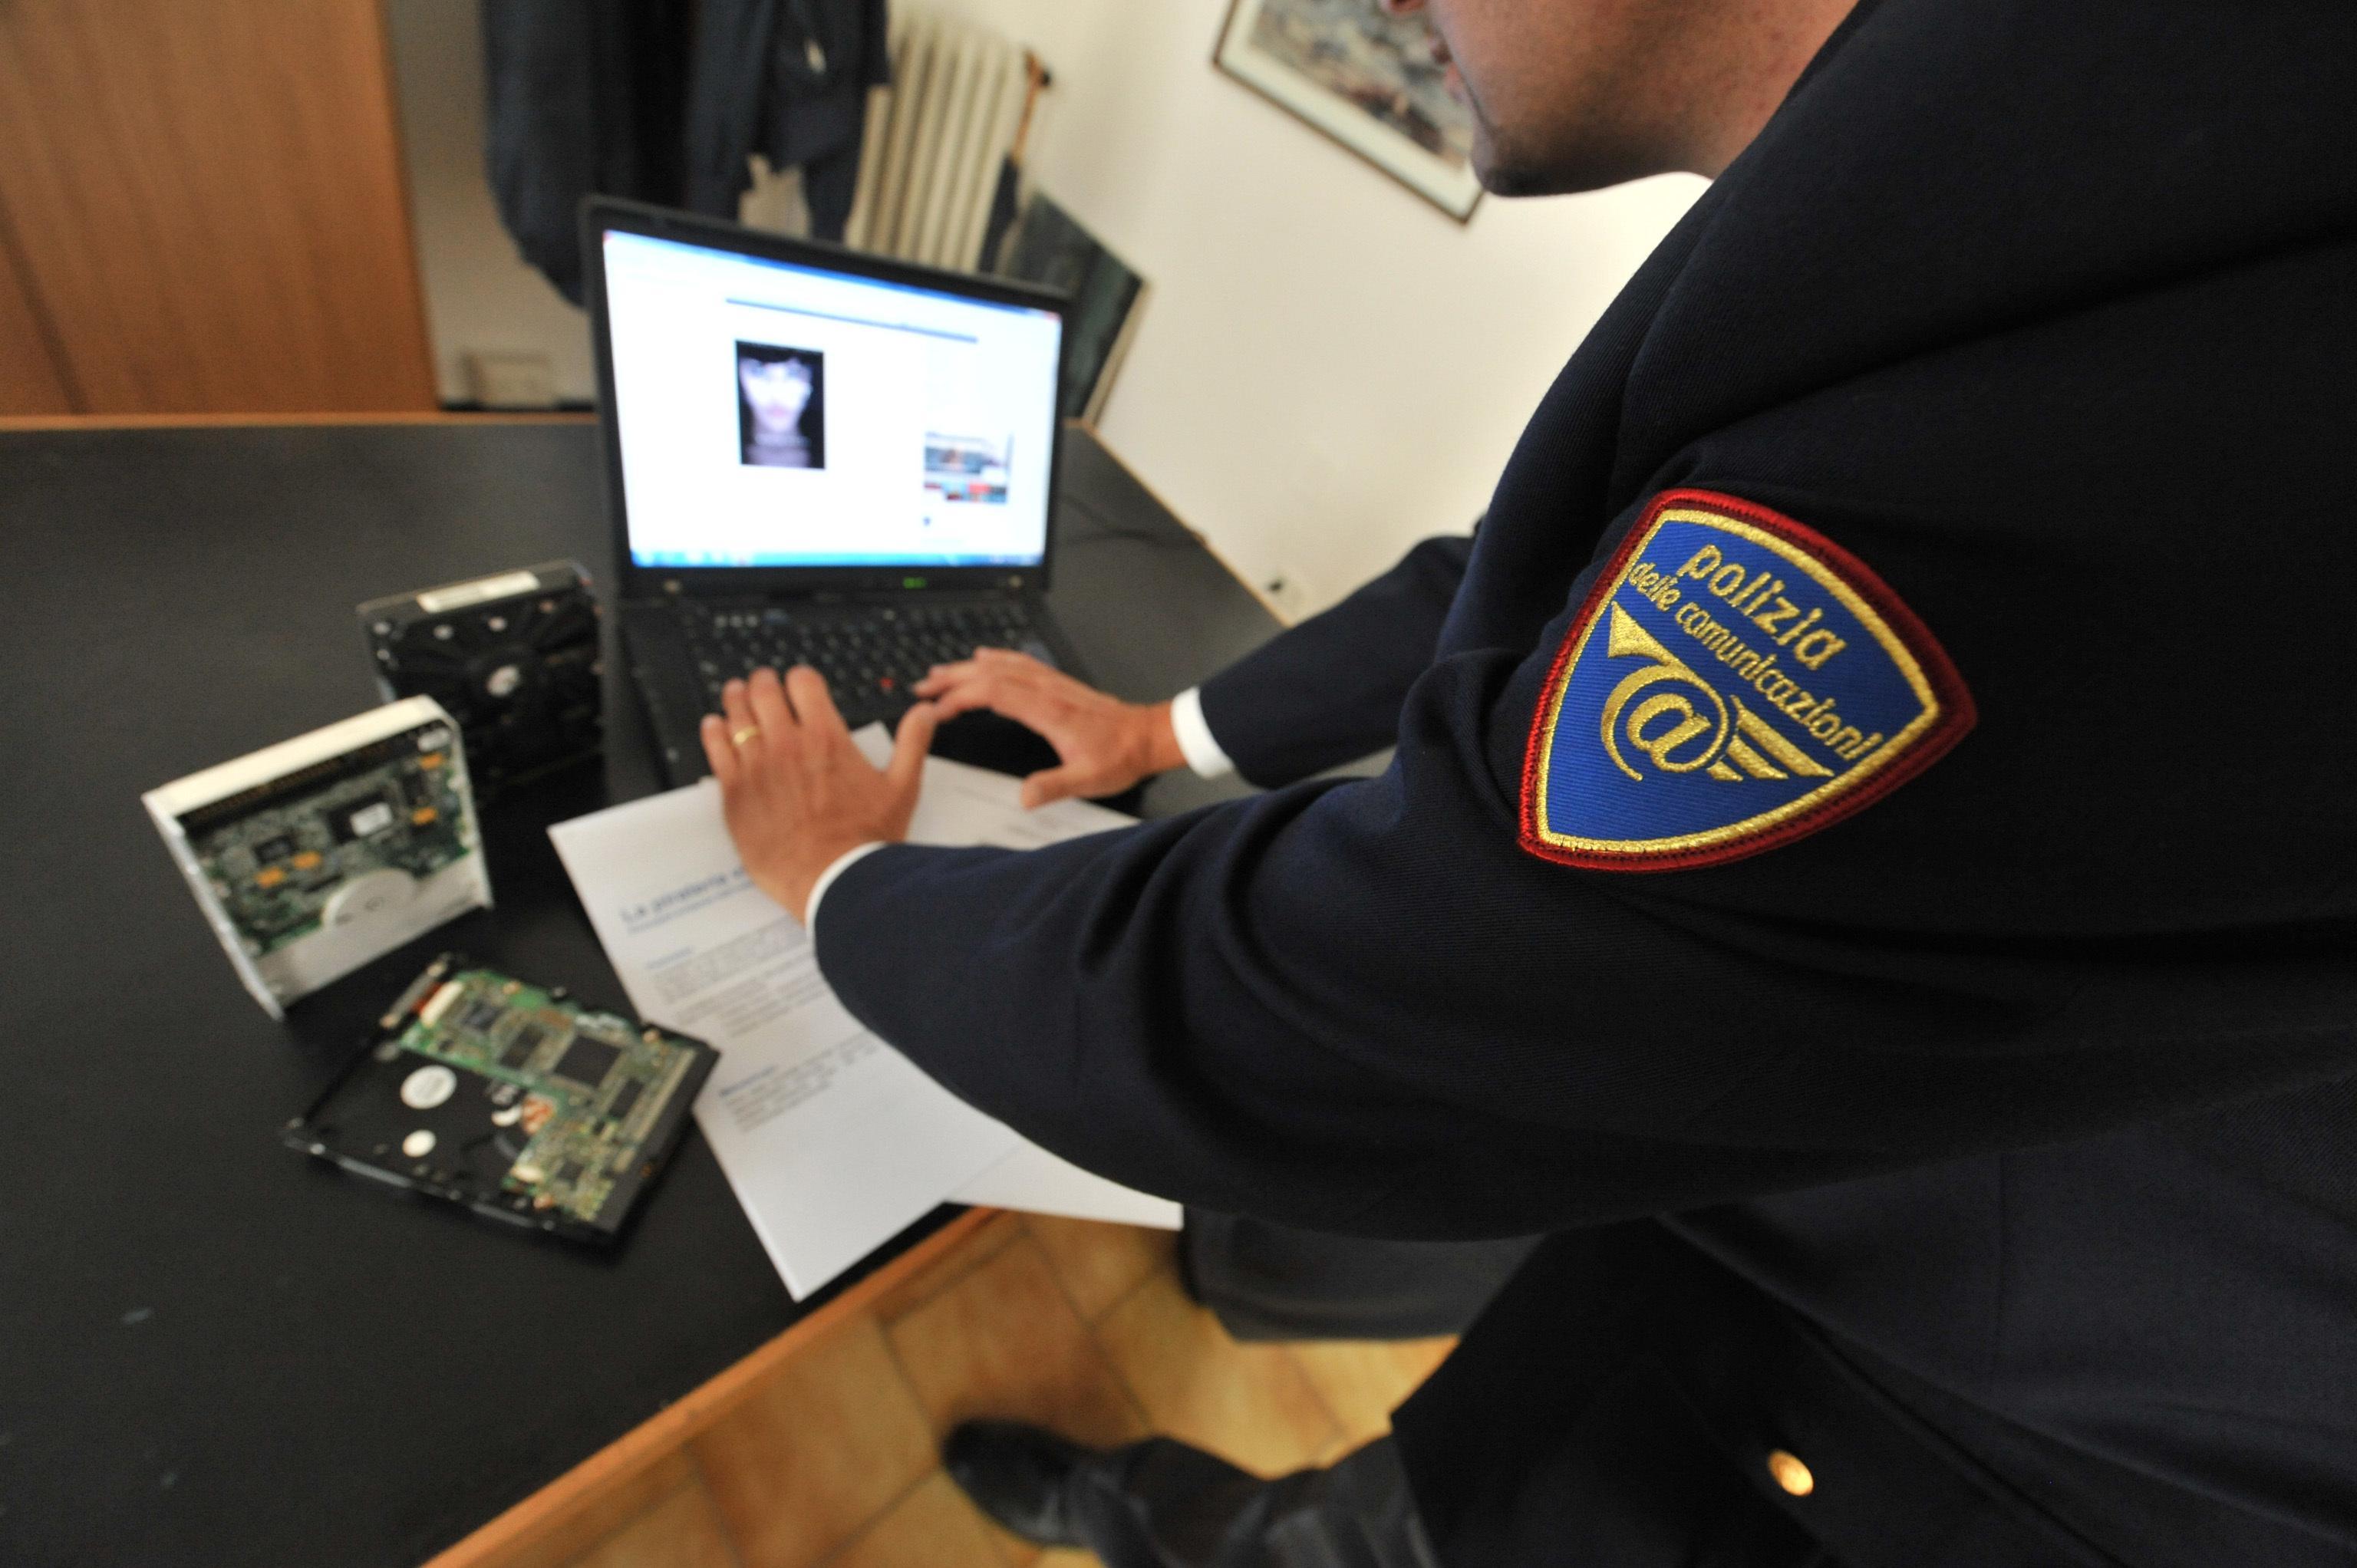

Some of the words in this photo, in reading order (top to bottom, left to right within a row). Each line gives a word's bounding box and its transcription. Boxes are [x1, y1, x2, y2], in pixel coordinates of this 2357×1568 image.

[1628, 562, 1681, 611] delle
[1674, 601, 1884, 760] comunicazioni
[1676, 544, 1847, 670] polizia
